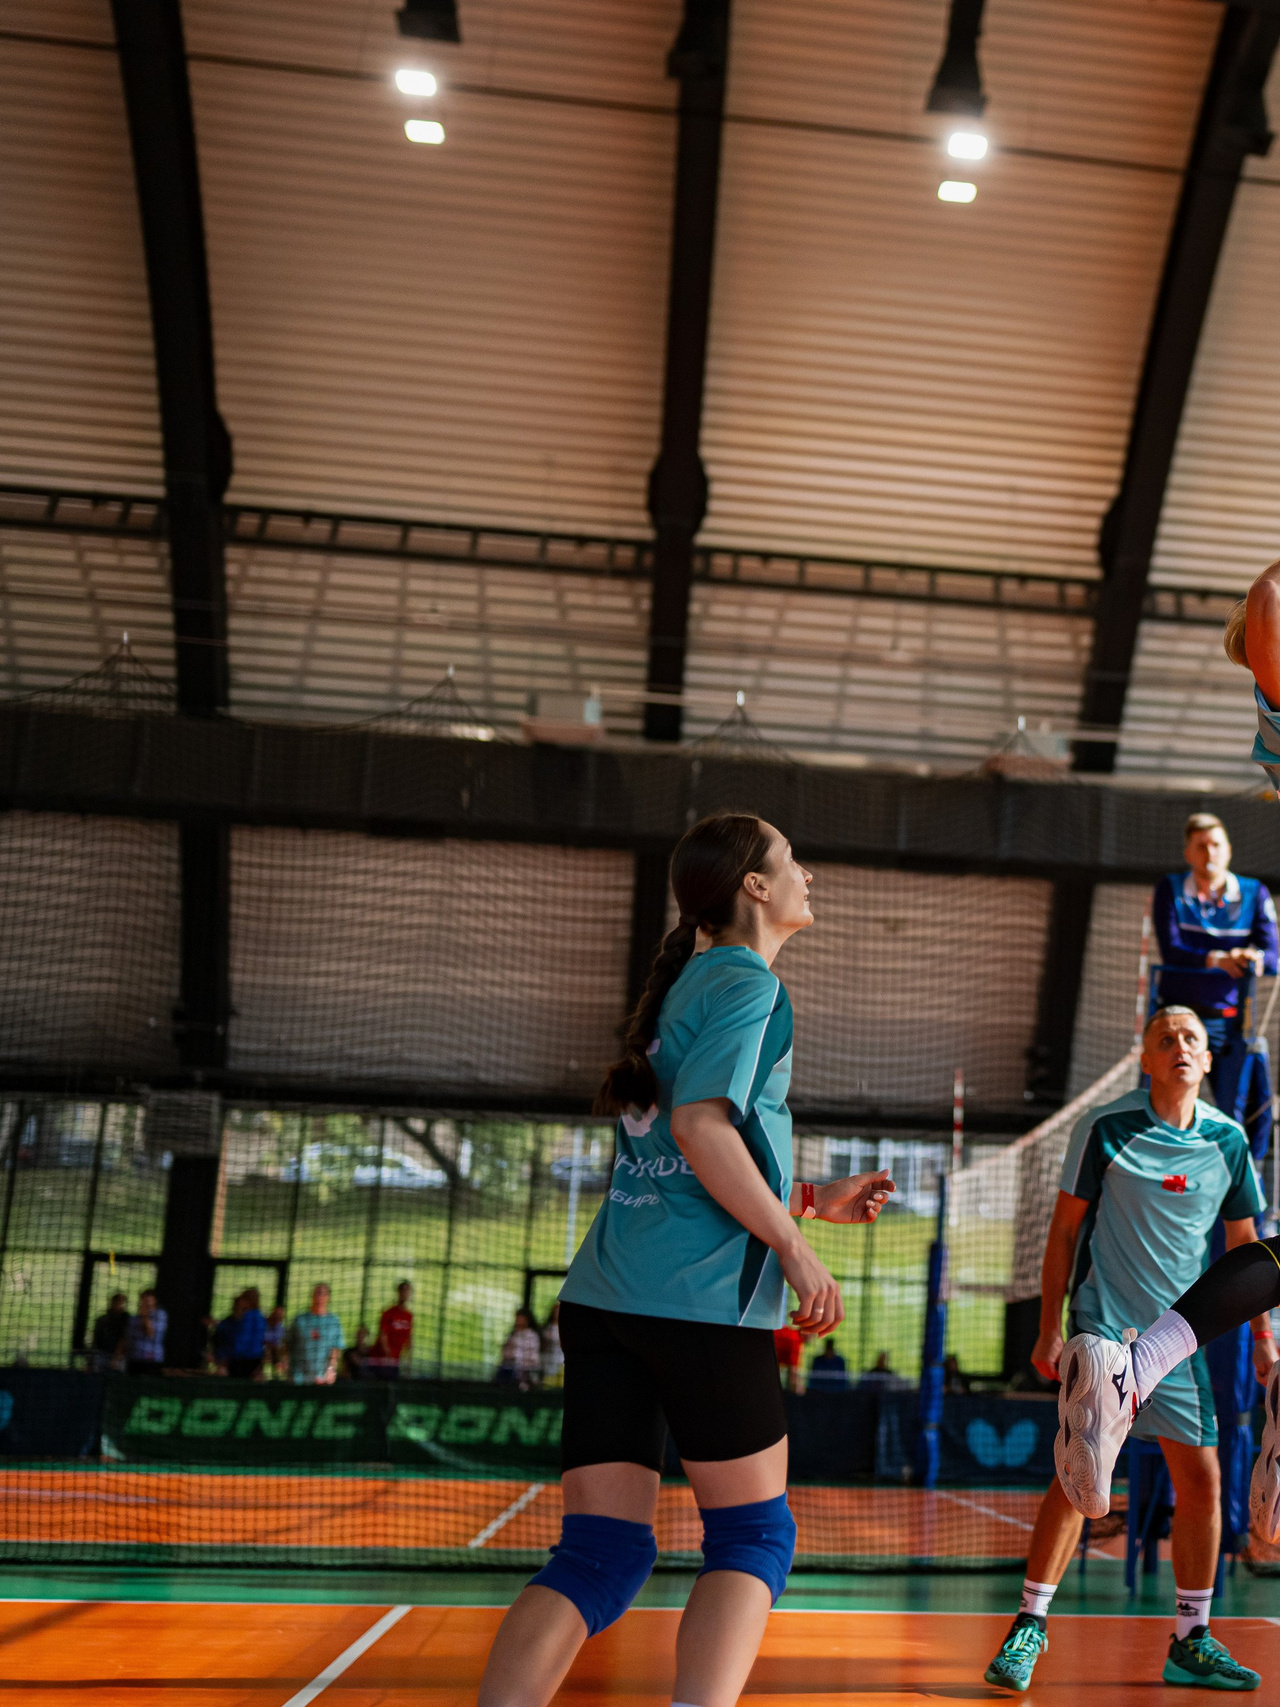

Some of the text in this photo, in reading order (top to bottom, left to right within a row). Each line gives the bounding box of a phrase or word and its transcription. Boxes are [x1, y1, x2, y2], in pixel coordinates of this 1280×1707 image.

[608, 1188, 660, 1208] БИРЬ
[124, 1396, 366, 1440] DONIC
[386, 1403, 564, 1446] DONI
